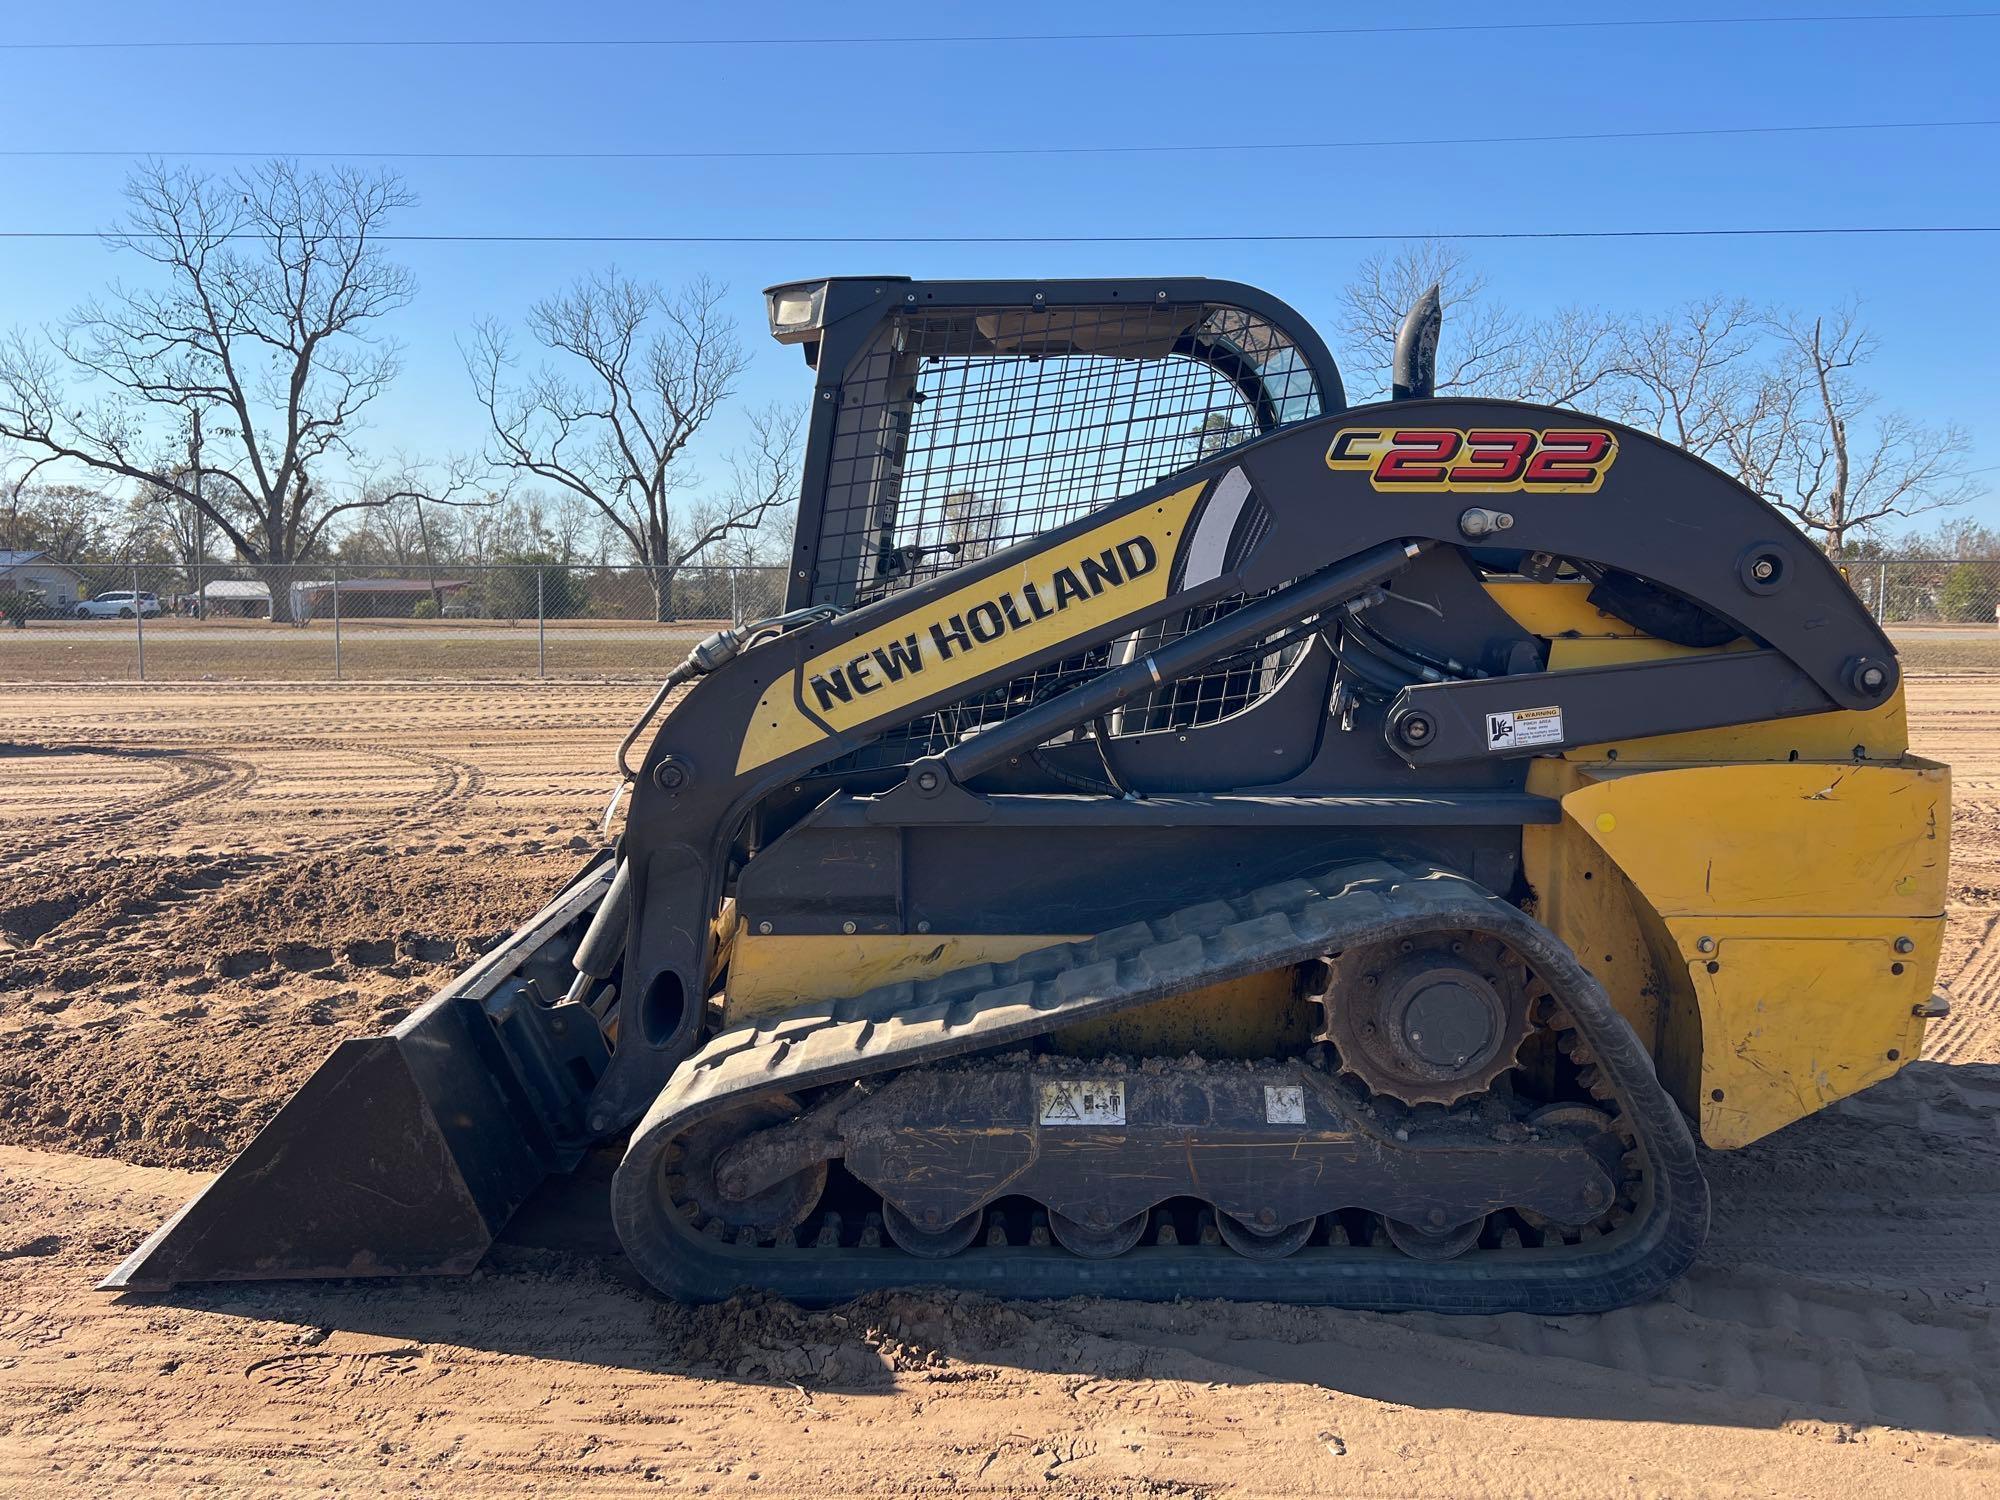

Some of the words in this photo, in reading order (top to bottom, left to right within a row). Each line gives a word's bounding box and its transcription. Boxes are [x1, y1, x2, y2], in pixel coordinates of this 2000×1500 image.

[809, 632, 925, 713] NEW
[927, 534, 1159, 661] HOLLAND
[1524, 710, 1557, 718] WARNING
